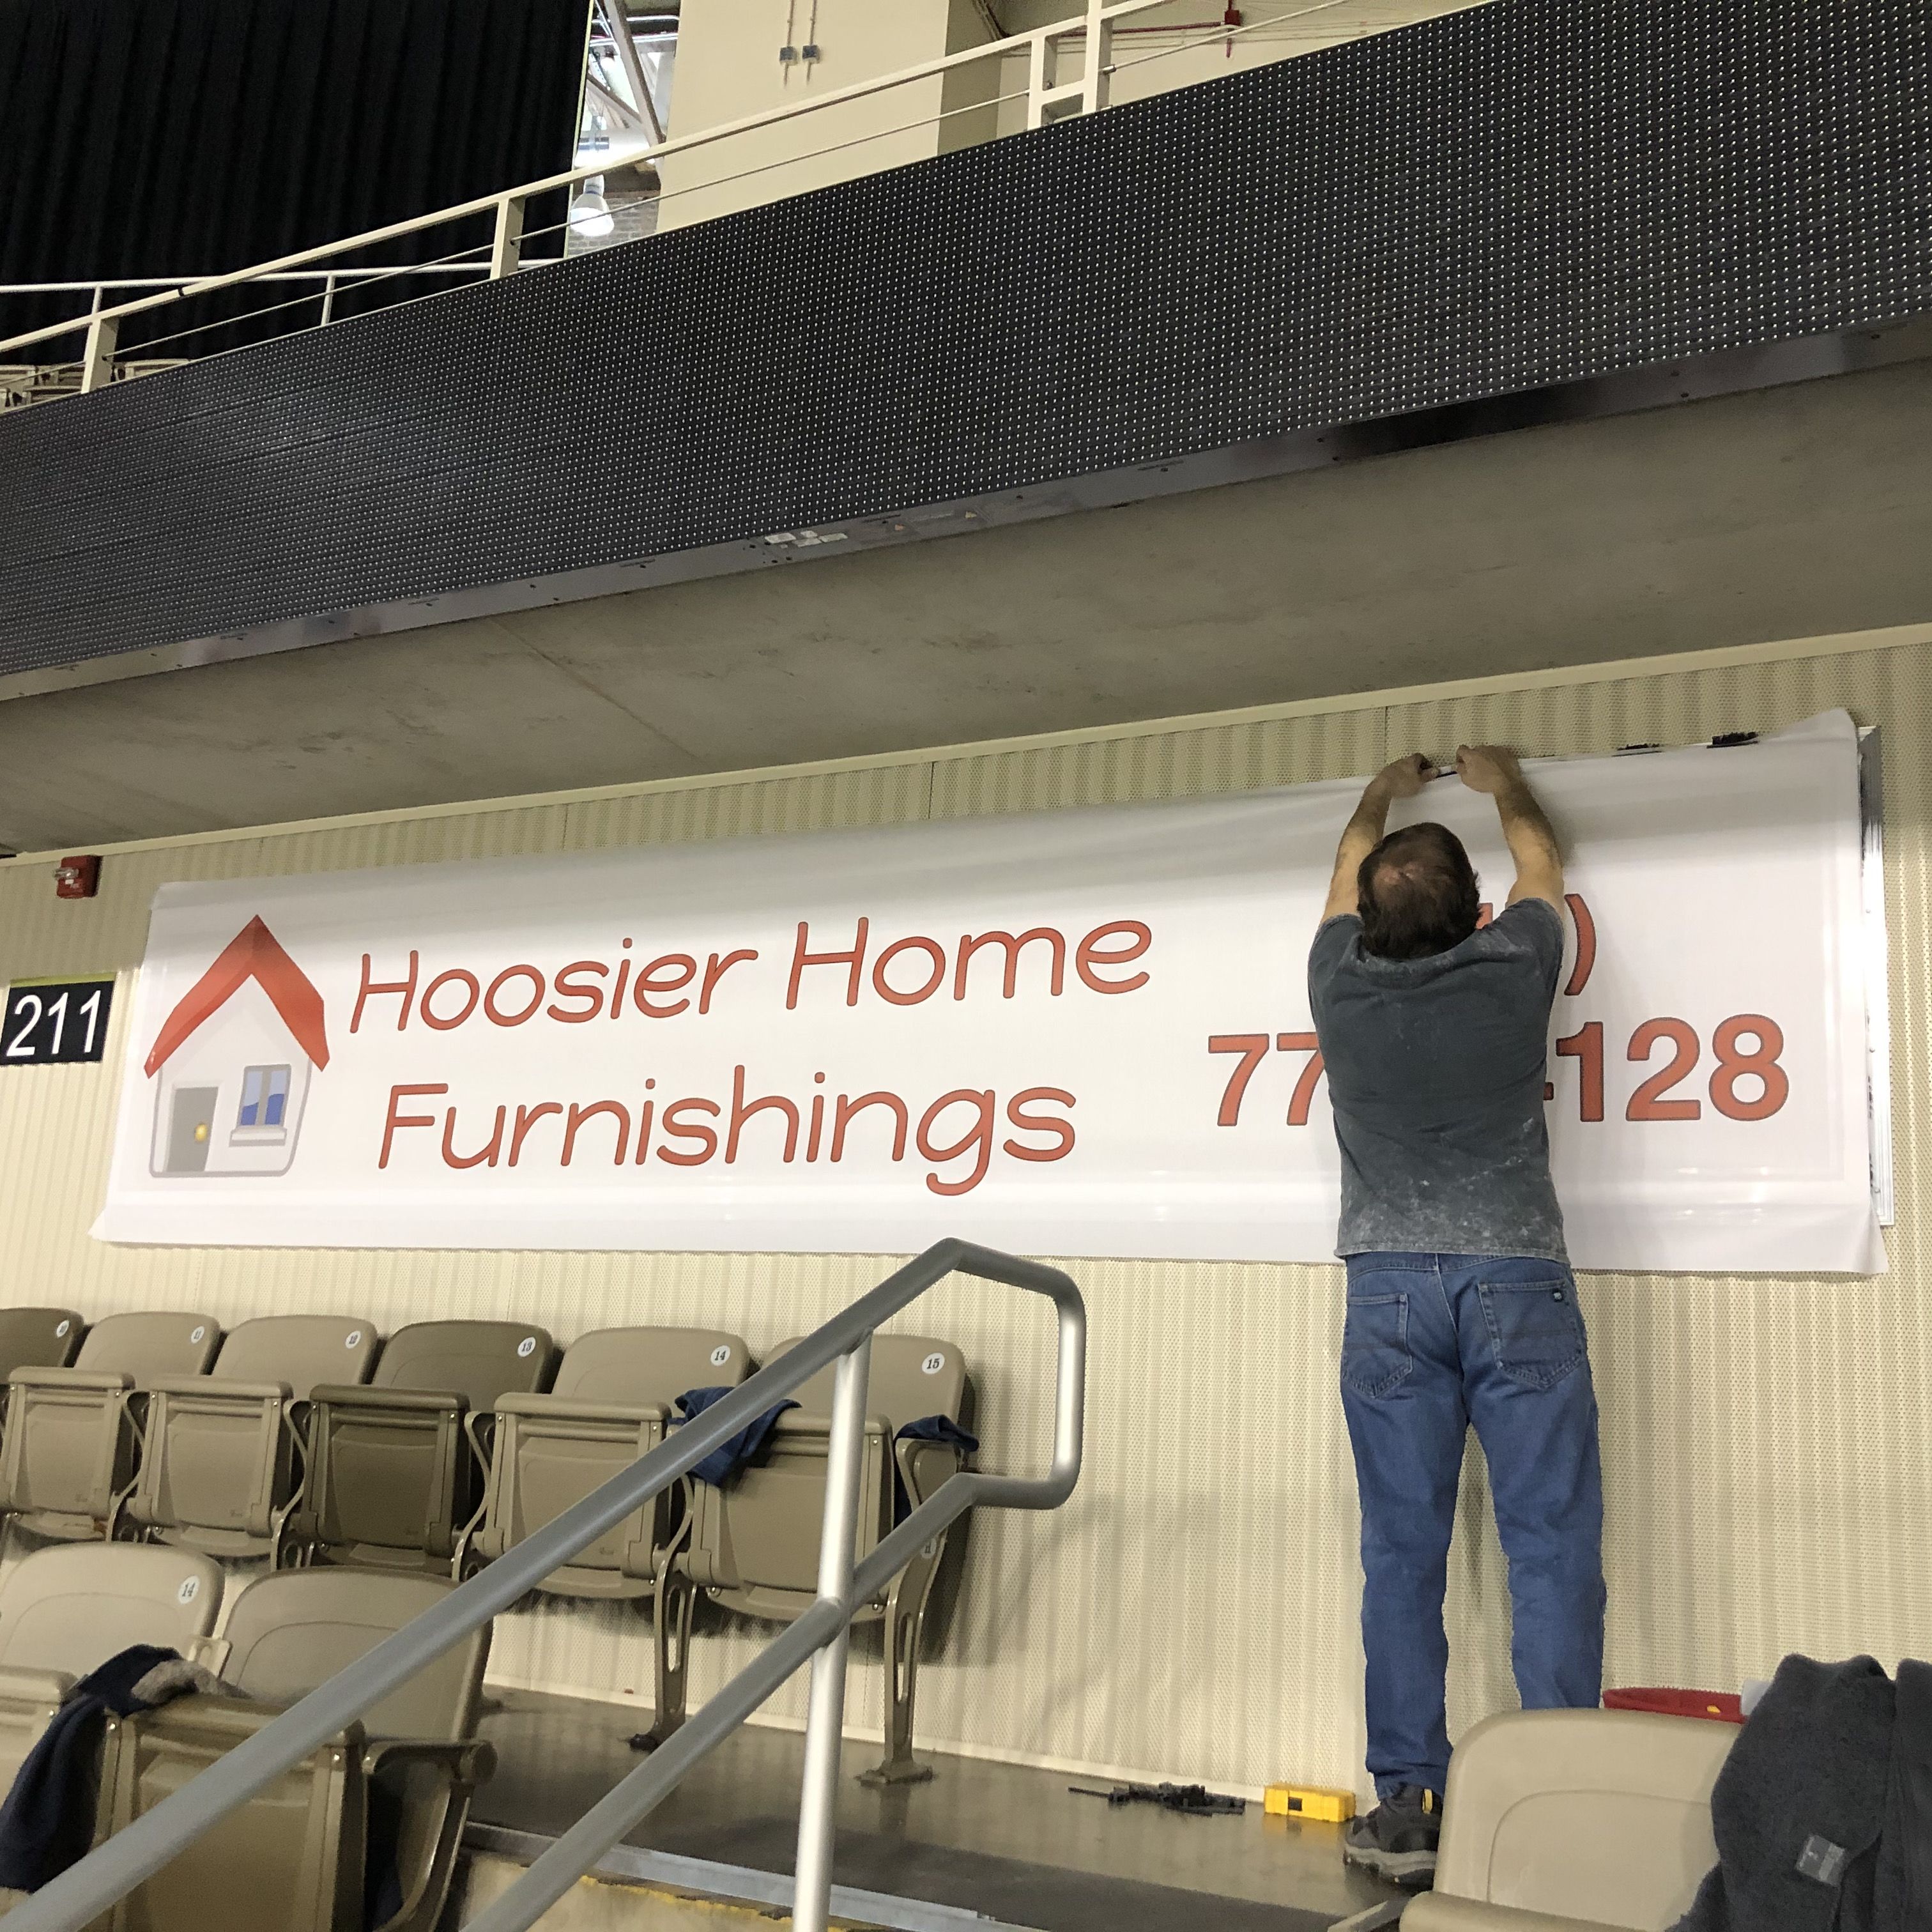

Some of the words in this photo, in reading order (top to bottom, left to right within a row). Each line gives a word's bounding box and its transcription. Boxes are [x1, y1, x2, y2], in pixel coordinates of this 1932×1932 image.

[349, 937, 759, 1033] Hoosier
[786, 916, 1153, 1010] Home
[6, 990, 101, 1057] 211
[378, 1064, 1077, 1197] Furnishings
[521, 1341, 533, 1353] 13
[714, 1350, 726, 1361] 14
[926, 1358, 940, 1369] 15
[181, 1582, 195, 1597] 14
